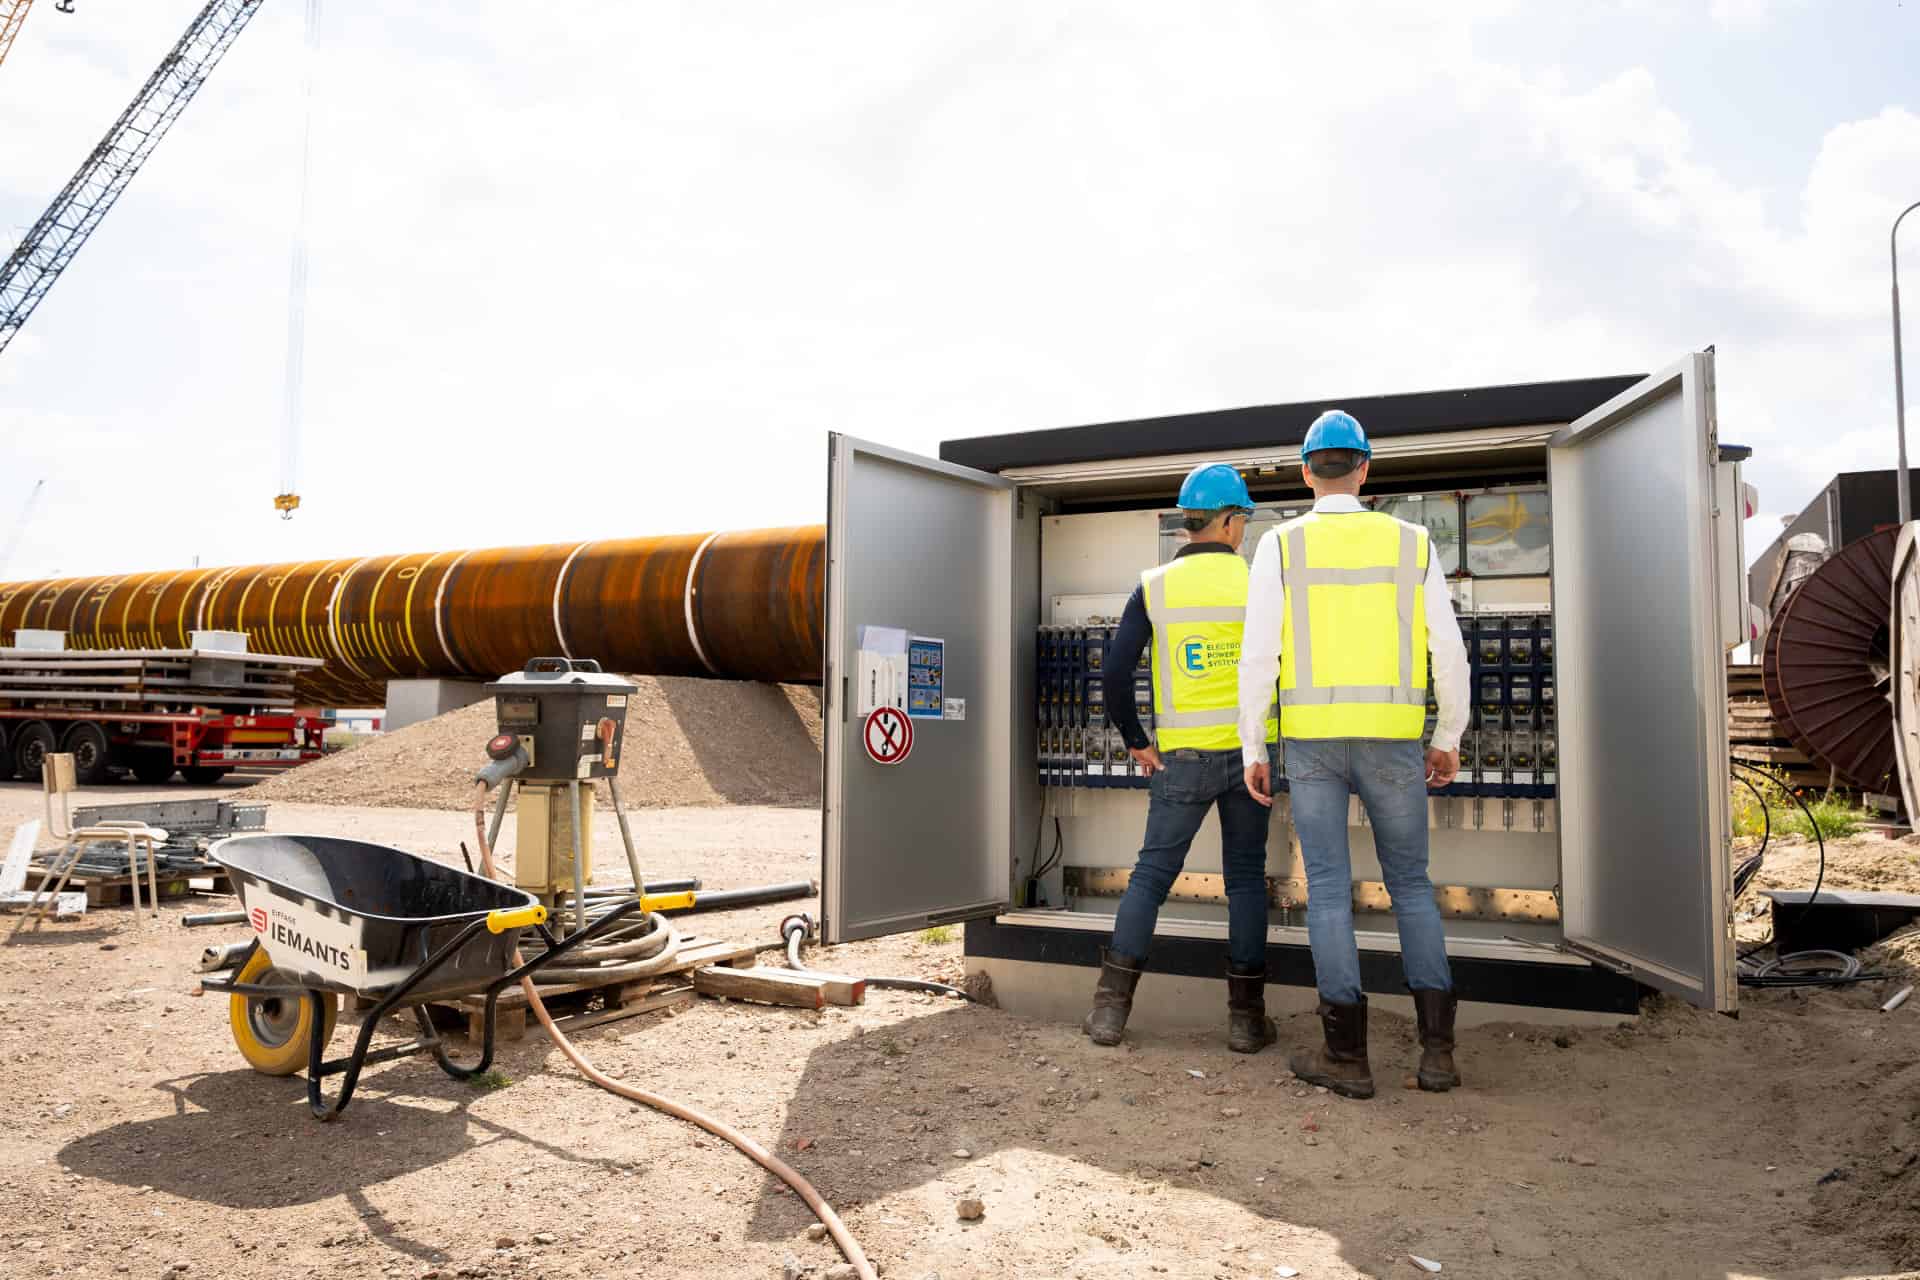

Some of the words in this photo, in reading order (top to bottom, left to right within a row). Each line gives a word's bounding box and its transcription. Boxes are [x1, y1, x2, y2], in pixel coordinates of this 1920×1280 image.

[1185, 643, 1205, 671] E
[1207, 651, 1234, 659] POWER
[1207, 659, 1241, 668] SYSTEM
[271, 921, 350, 971] IEMANTS
